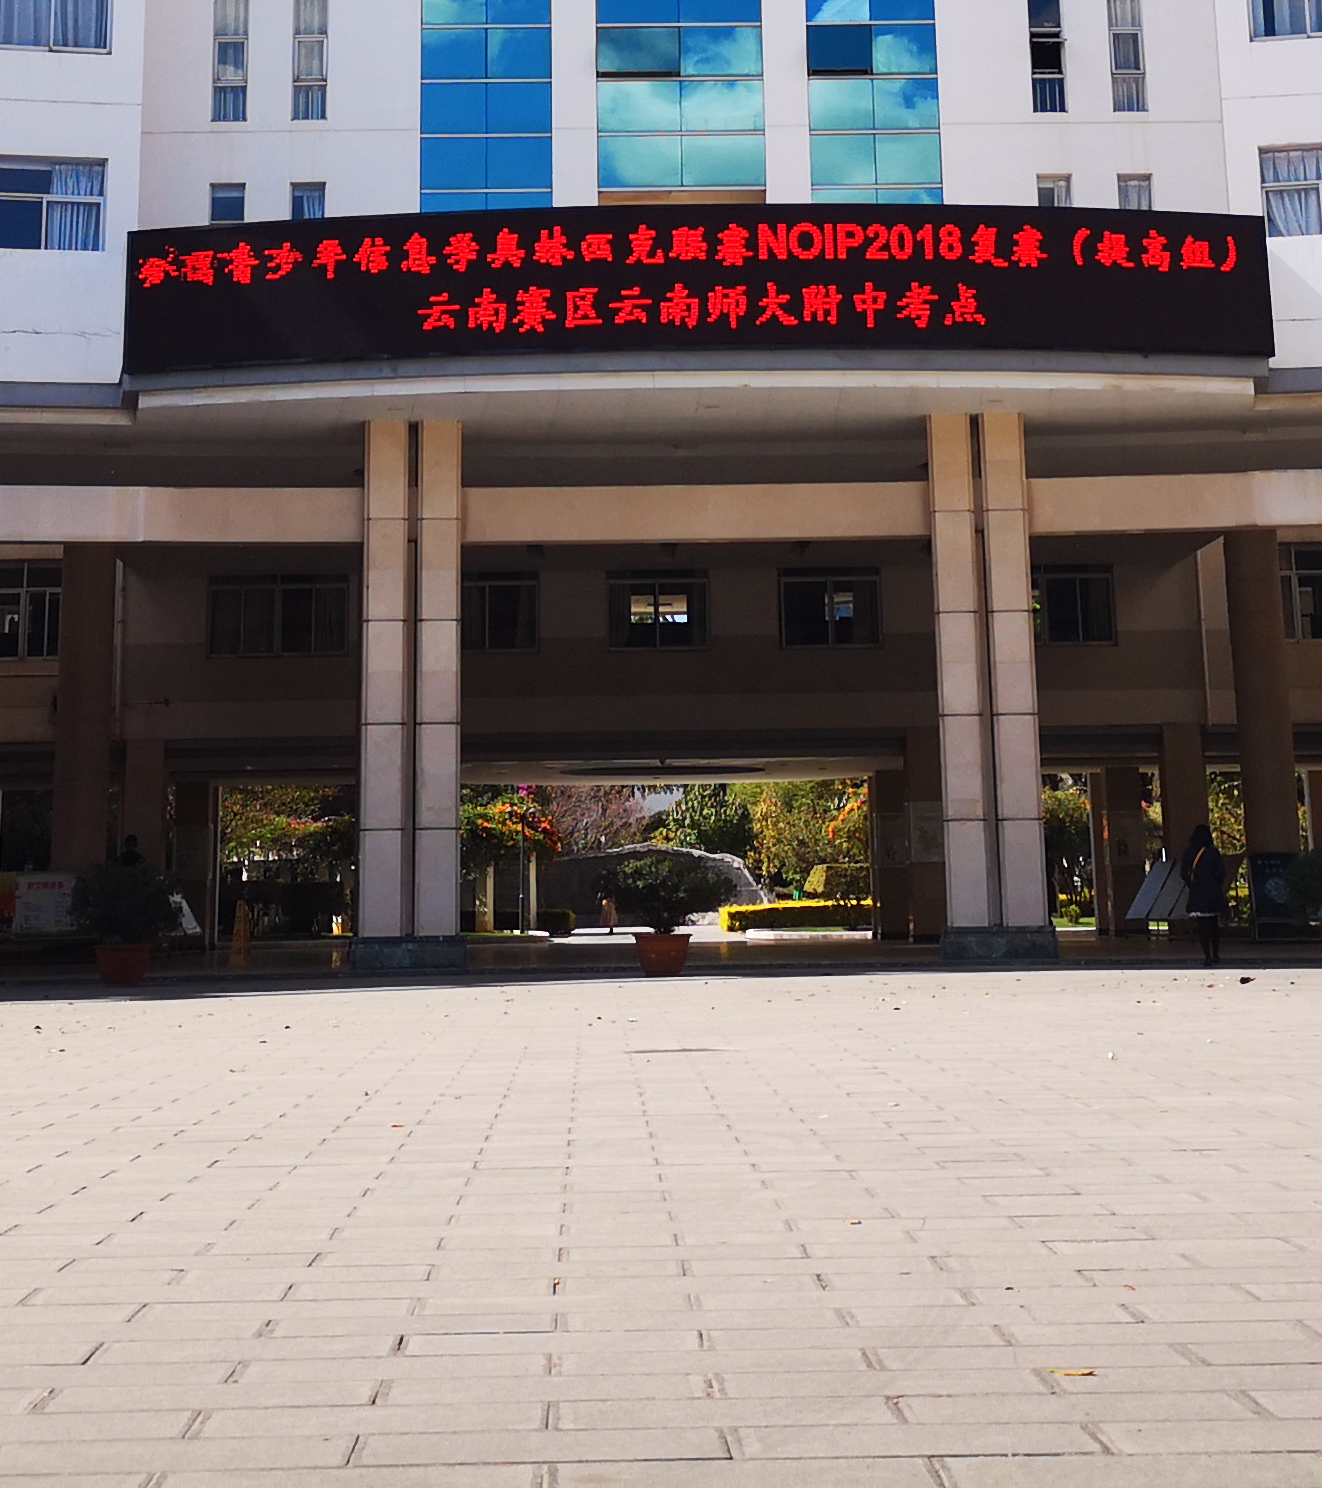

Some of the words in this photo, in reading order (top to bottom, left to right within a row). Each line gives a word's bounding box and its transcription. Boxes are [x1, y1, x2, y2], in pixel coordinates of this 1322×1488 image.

[417, 281, 987, 334] 云南赛区云南师大附中考点
